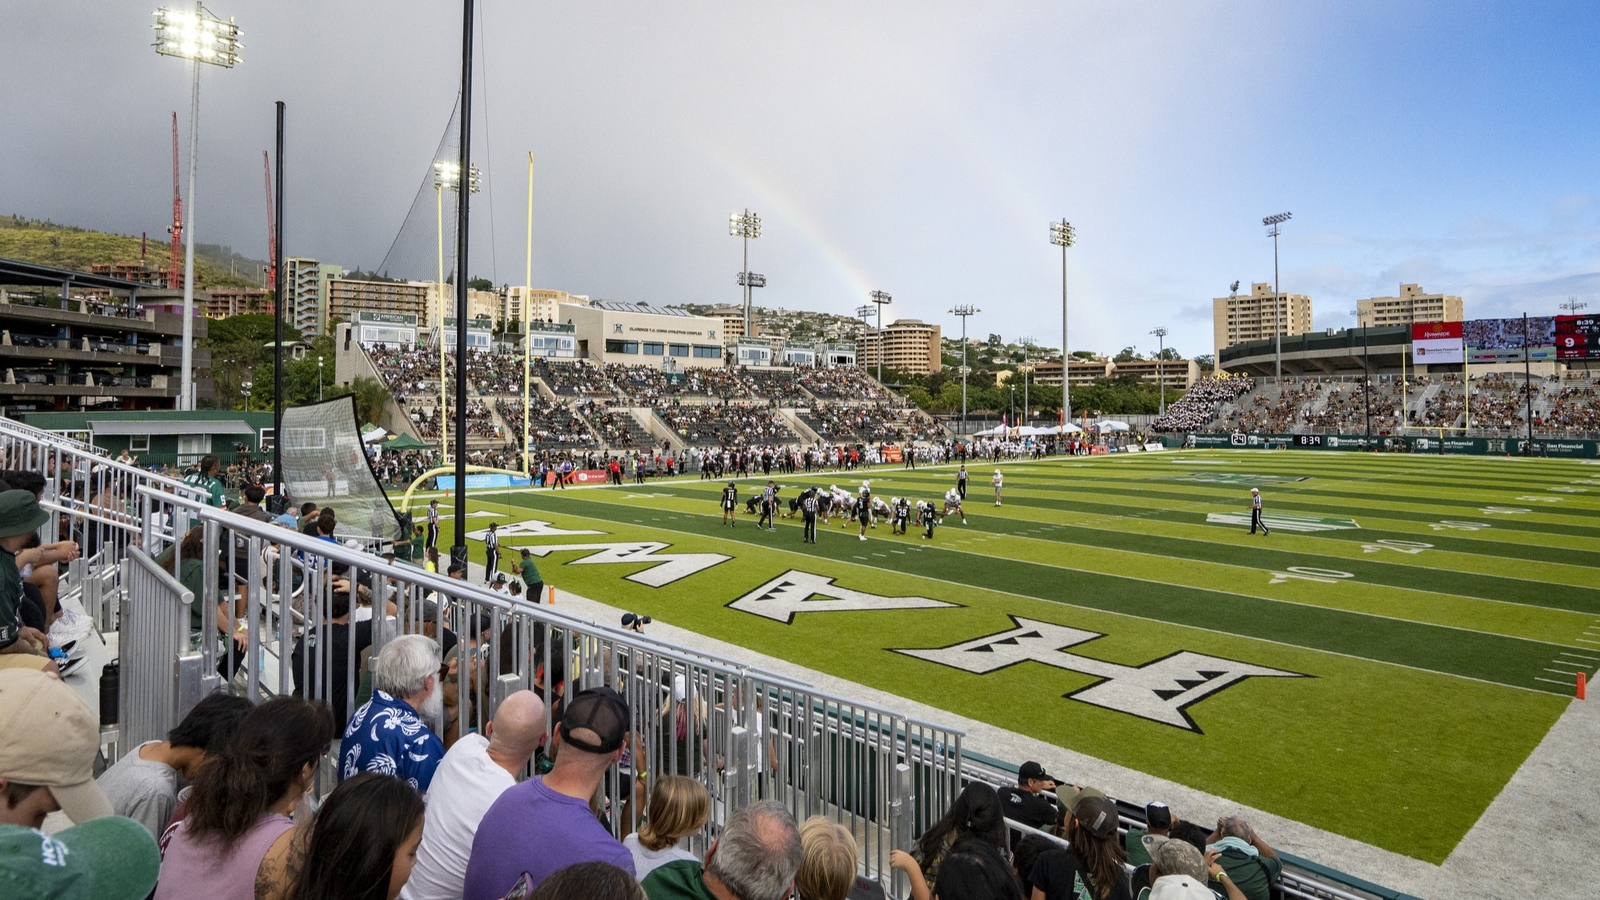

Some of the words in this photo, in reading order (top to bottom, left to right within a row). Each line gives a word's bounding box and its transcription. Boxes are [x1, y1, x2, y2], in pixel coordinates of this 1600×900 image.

[1564, 337, 1575, 347] 9
[1233, 434, 1245, 444] 24
[1301, 435, 1320, 445] 8:39
[728, 492, 735, 500] 11
[898, 508, 907, 517] 29
[1360, 539, 1435, 555] 20
[1268, 566, 1355, 585] 10
